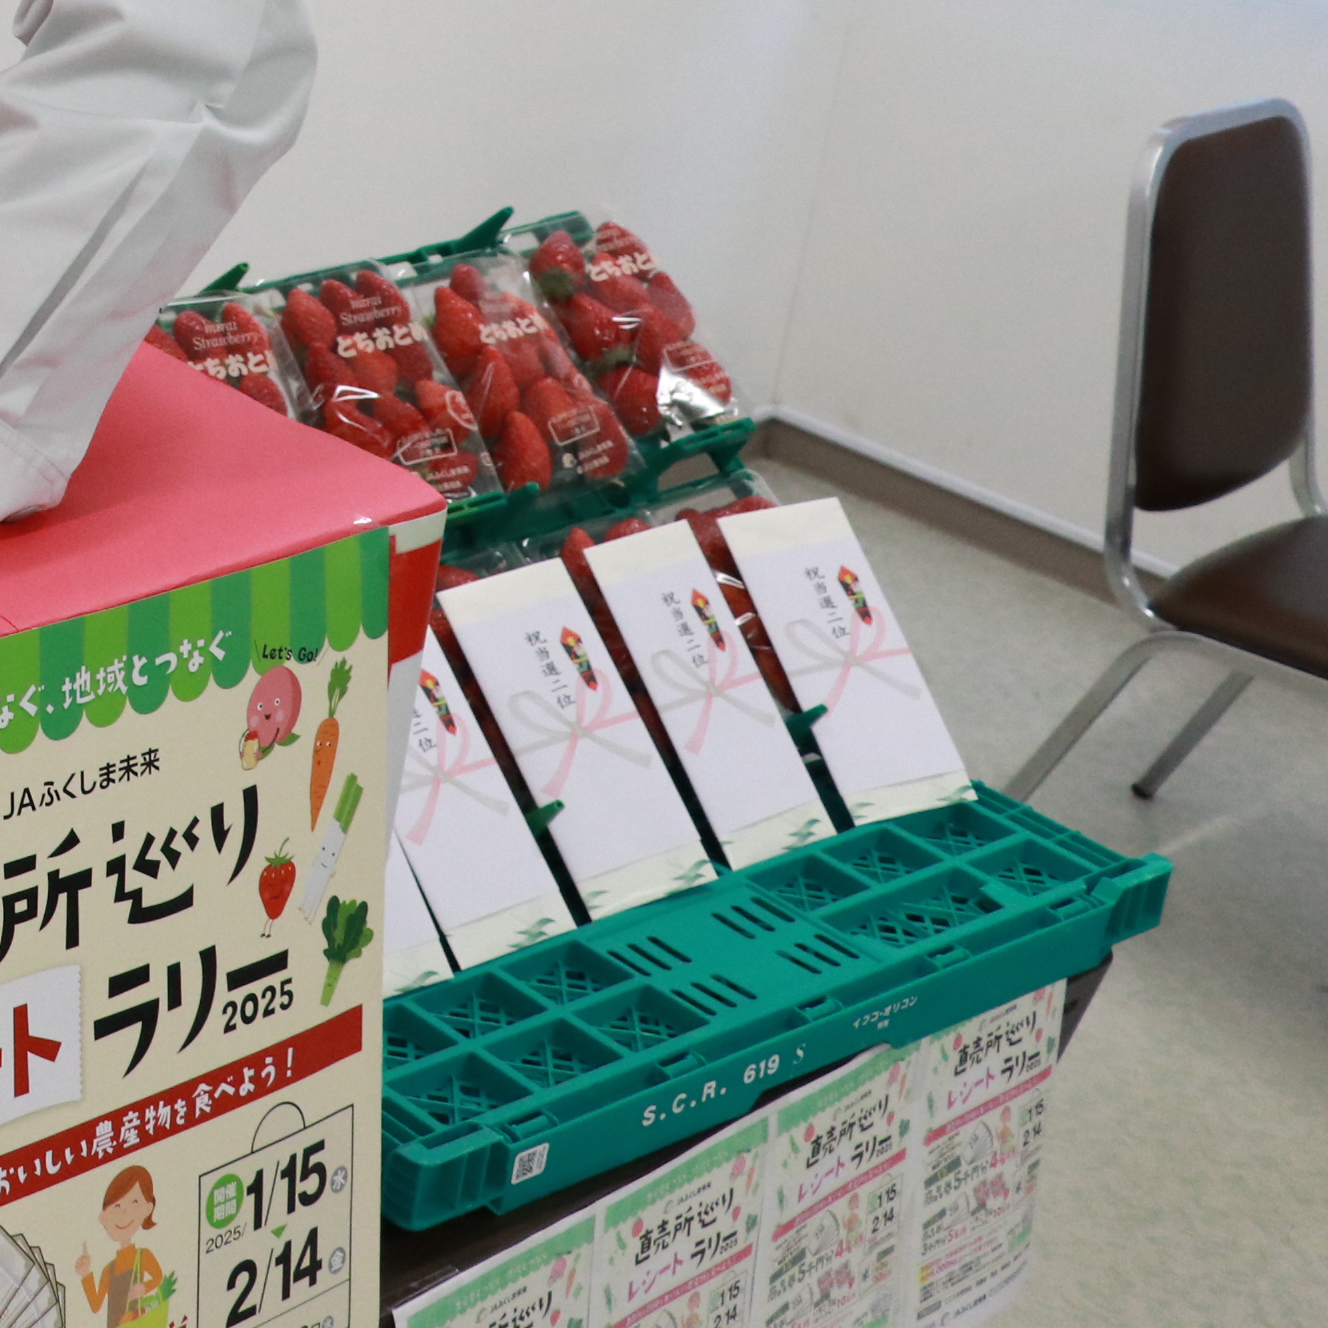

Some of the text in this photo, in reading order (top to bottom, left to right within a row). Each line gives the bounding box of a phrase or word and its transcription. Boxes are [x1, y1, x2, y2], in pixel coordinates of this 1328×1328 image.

[262, 644, 318, 662] Let's Go!
[2, 747, 160, 820] JAふくしま未来
[93, 945, 289, 1078] ラリー
[221, 977, 295, 1034] 2025
[743, 1053, 781, 1084] 619
[635, 1187, 734, 1266] 直売所巡り
[628, 1252, 684, 1303] レシート
